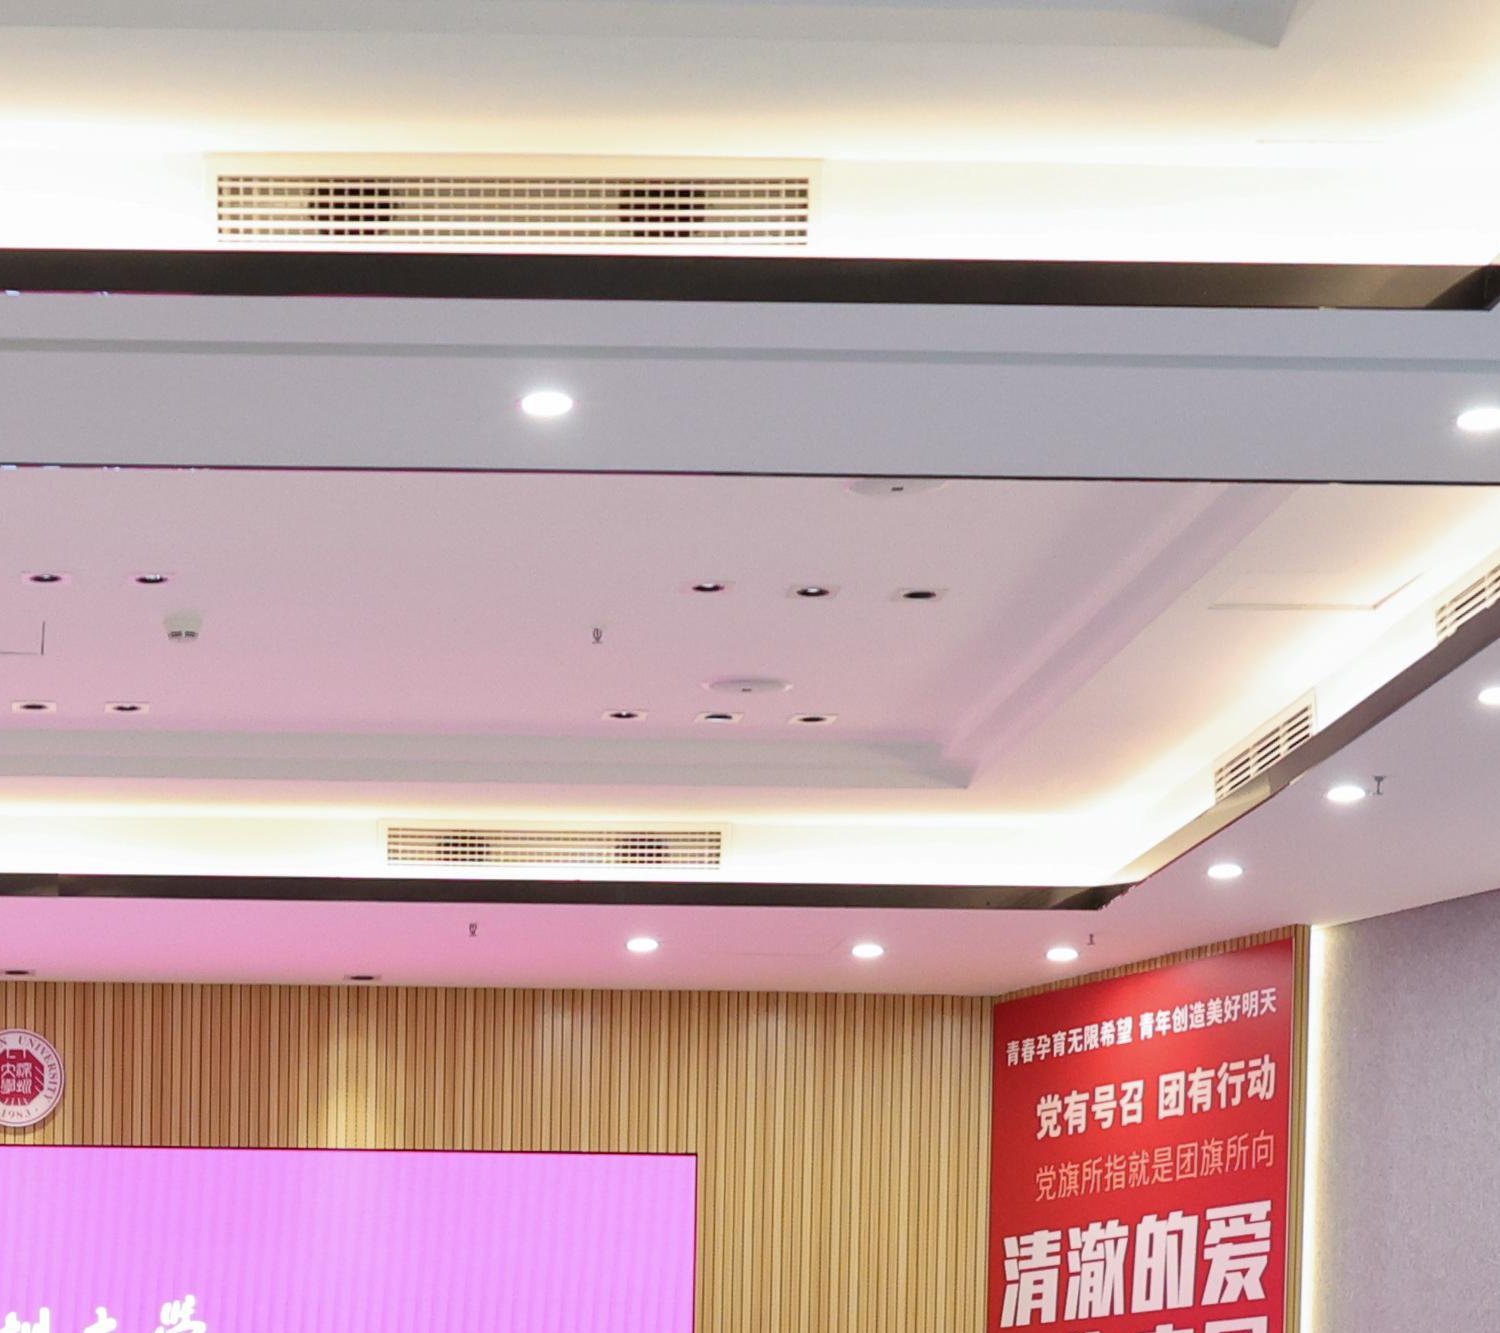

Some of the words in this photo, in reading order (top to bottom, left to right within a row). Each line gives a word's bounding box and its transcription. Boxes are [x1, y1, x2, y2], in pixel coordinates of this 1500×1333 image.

[1006, 1016, 1133, 1067] 青春孕育无限希望
[1139, 987, 1277, 1041] 青年创造美好明天
[18, 1035, 58, 1101] UNIVERSITY
[1036, 1079, 1145, 1140] 党有号召
[1158, 1054, 1276, 1121] 团有行动
[1035, 1129, 1275, 1203] 党旗所指就是团旗所向
[1000, 1200, 1272, 1329] 清澈的爱
